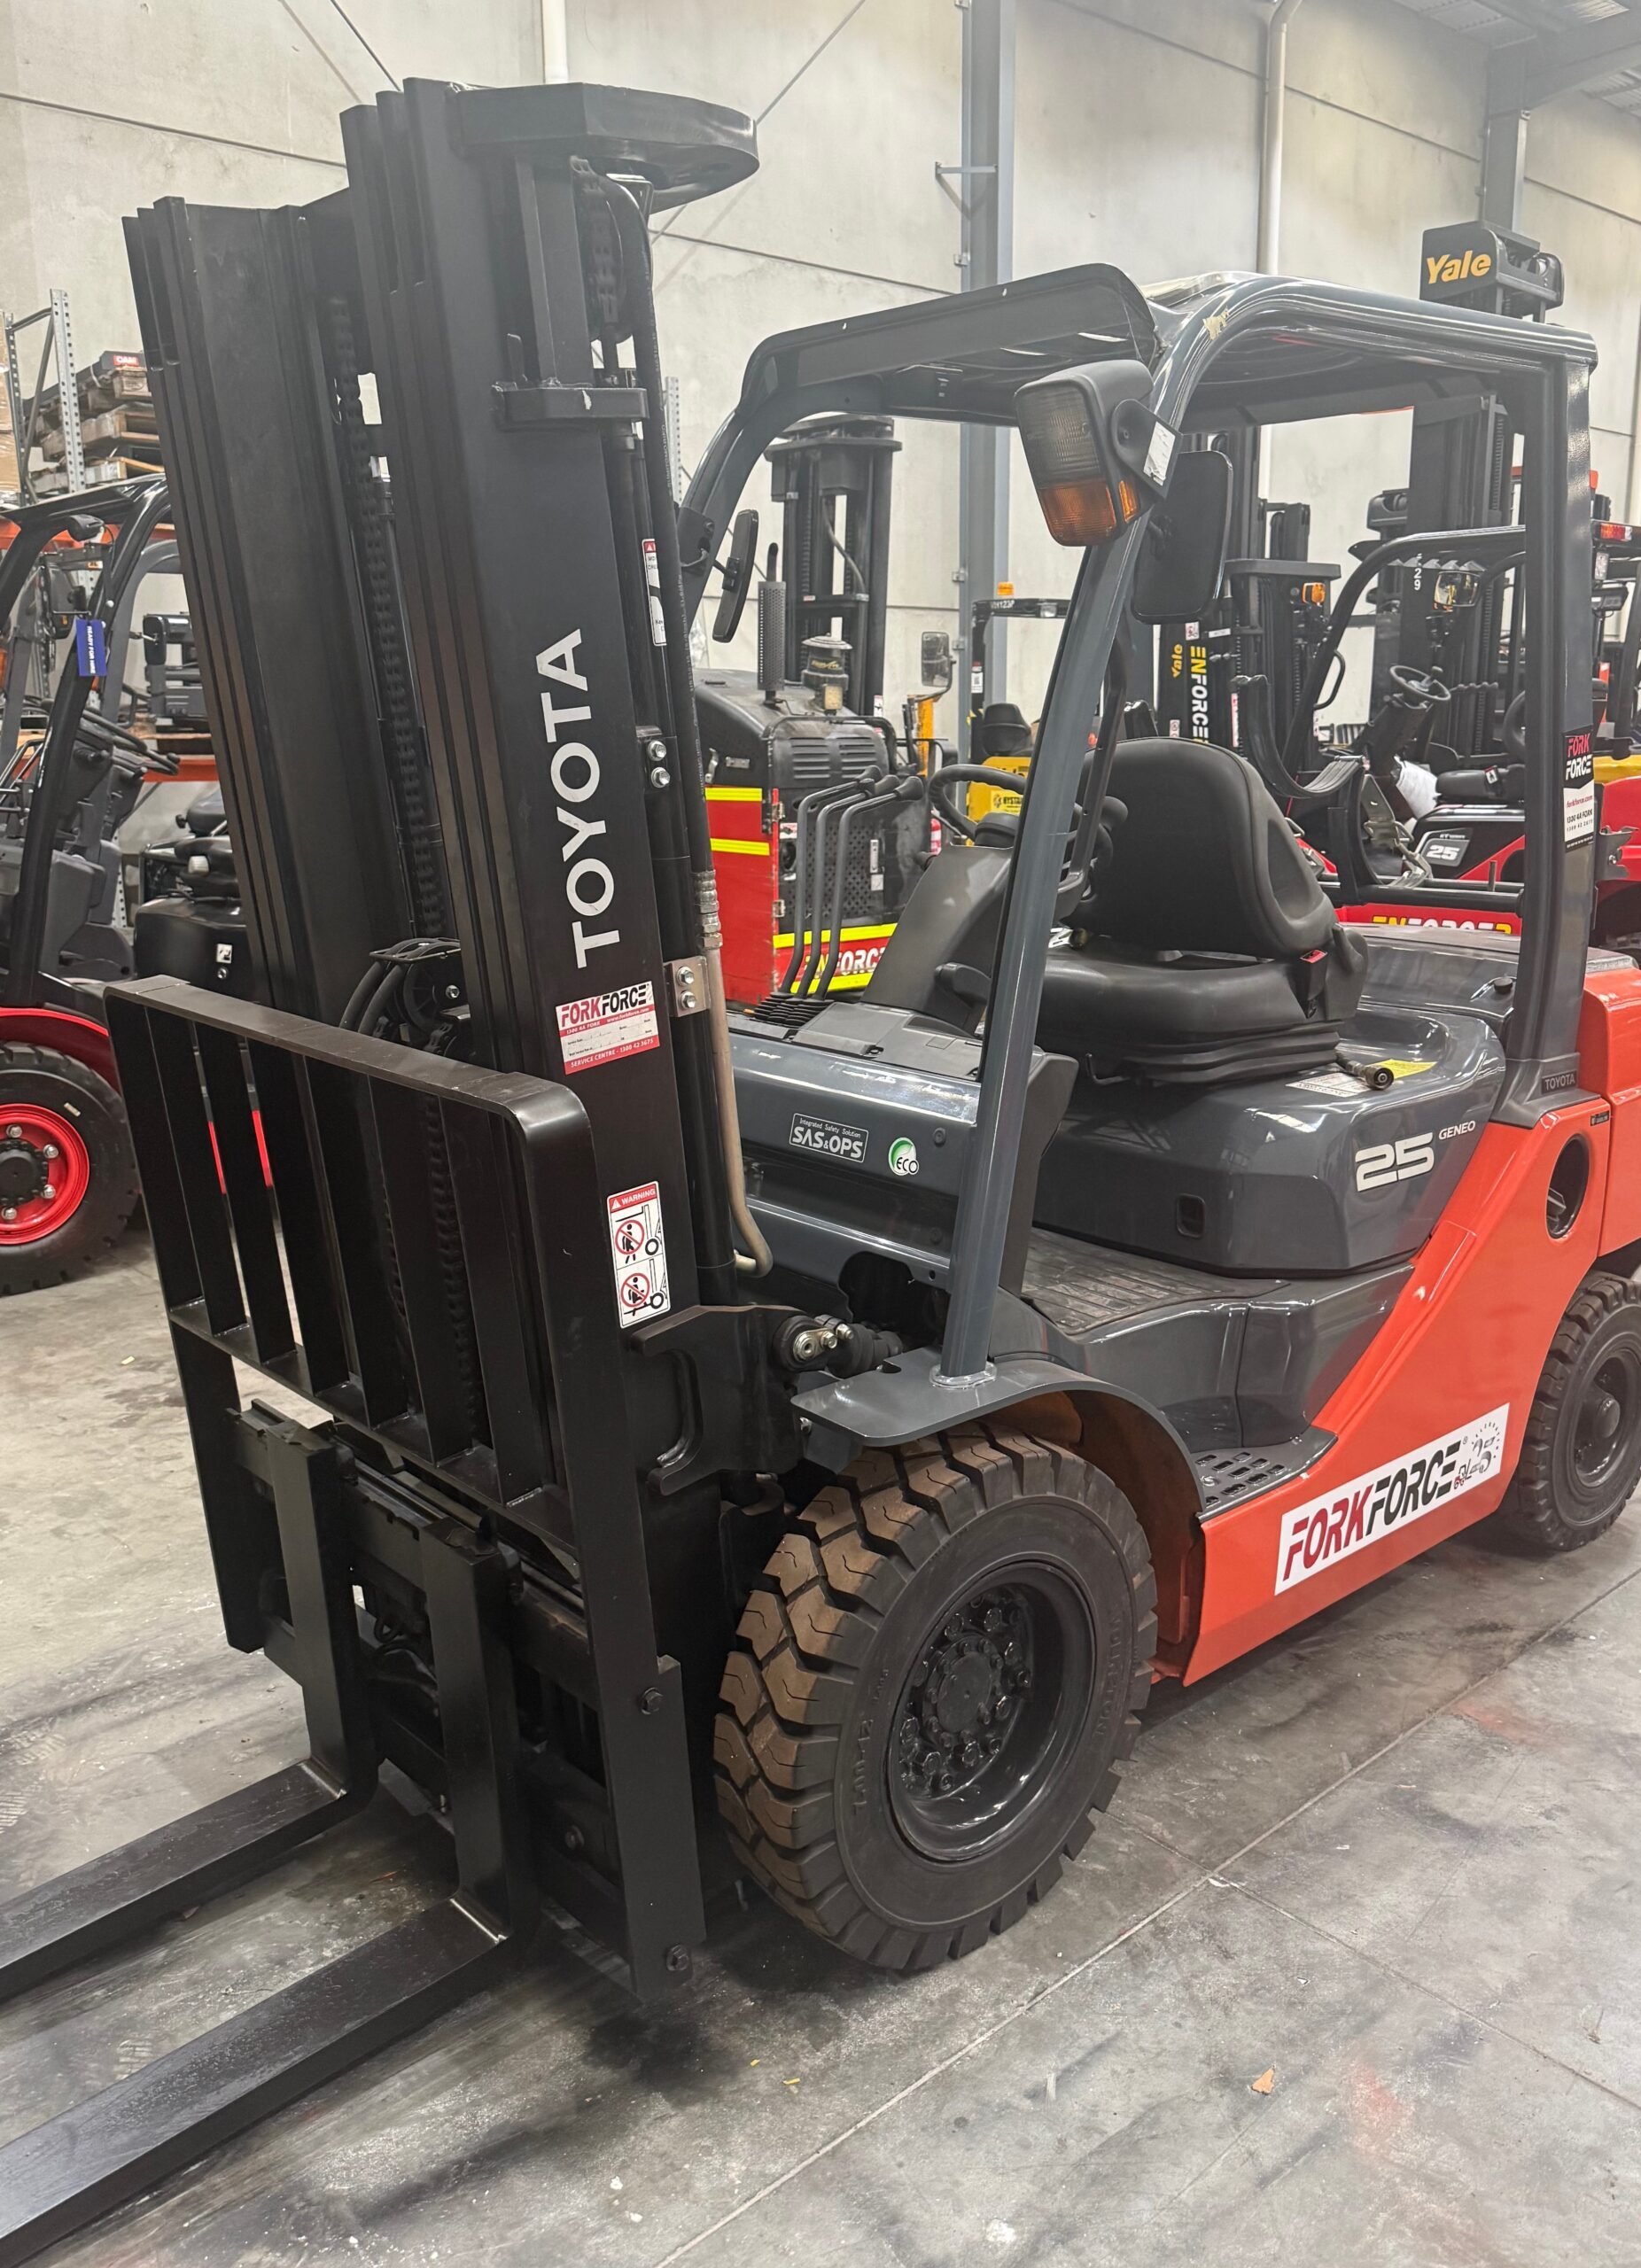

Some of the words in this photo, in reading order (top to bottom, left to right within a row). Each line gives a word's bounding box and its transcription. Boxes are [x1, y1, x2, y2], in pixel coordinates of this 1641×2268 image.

[1426, 250, 1491, 284] Yale
[1171, 643, 1183, 678] Yale
[1567, 733, 1590, 757] FORK
[1566, 754, 1592, 781] FORCE
[536, 628, 620, 969] TOYOTA
[1426, 844, 1460, 861] 25
[562, 983, 647, 1028] FORKFORCE
[571, 1057, 594, 1068] SERVICE
[594, 1049, 615, 1060] CENTRE
[619, 1045, 632, 1053] 1300
[1544, 1073, 1575, 1091] TOYOTA
[799, 1117, 822, 1129] Integrated
[824, 1123, 840, 1134] Safety
[842, 1128, 861, 1138] Solution
[1438, 1120, 1476, 1140] GENEO
[896, 1156, 919, 1174] ECO
[1355, 1131, 1435, 1192] 25
[621, 1188, 656, 1206] WARNING
[1283, 1440, 1462, 1581] FORKFORCE
